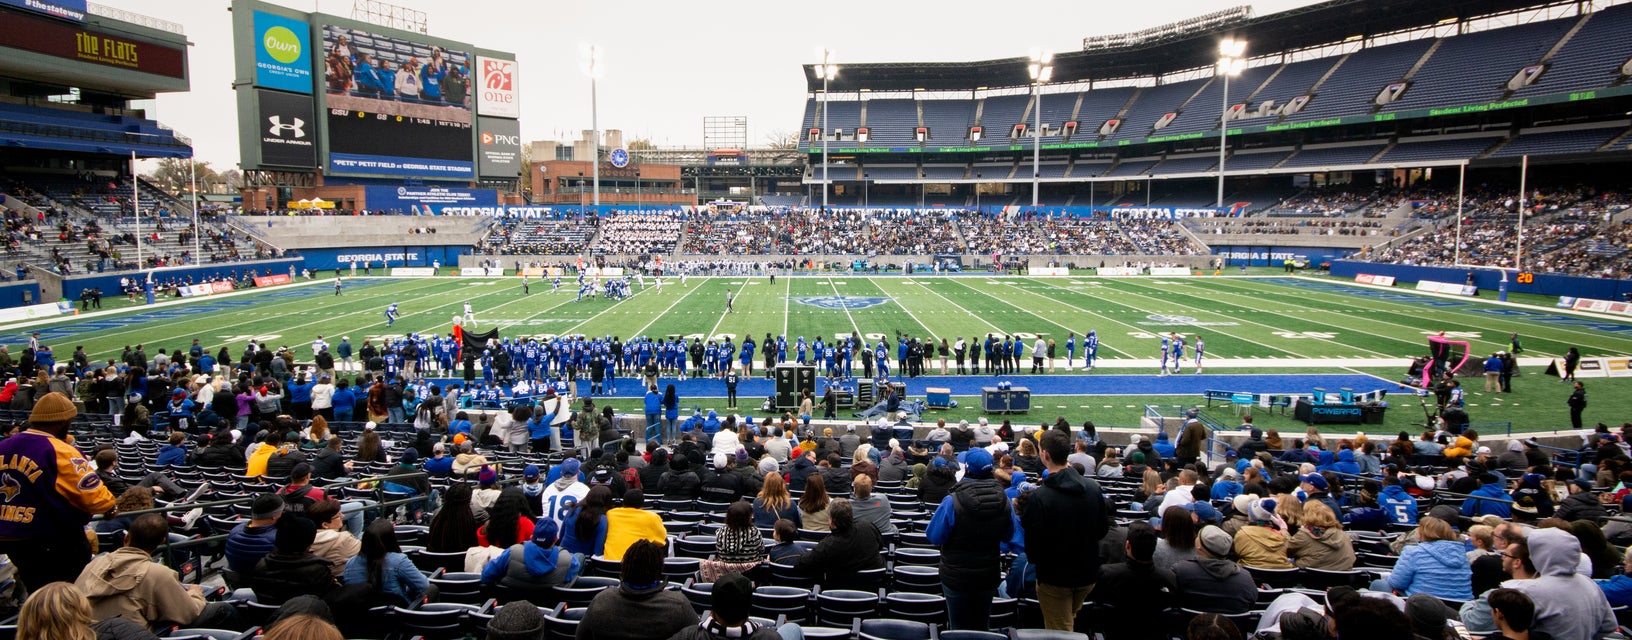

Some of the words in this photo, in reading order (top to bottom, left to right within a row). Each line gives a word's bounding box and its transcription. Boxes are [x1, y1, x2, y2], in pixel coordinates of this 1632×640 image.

[266, 36, 298, 53] Own
[484, 91, 512, 103] one
[1462, 105, 1489, 113] Living
[1489, 99, 1528, 109] Perfected
[495, 134, 519, 145] PNC
[337, 254, 382, 262] GEORGIA
[1516, 273, 1534, 283] 20
[548, 495, 578, 521] 18
[1395, 505, 1408, 522] 5
